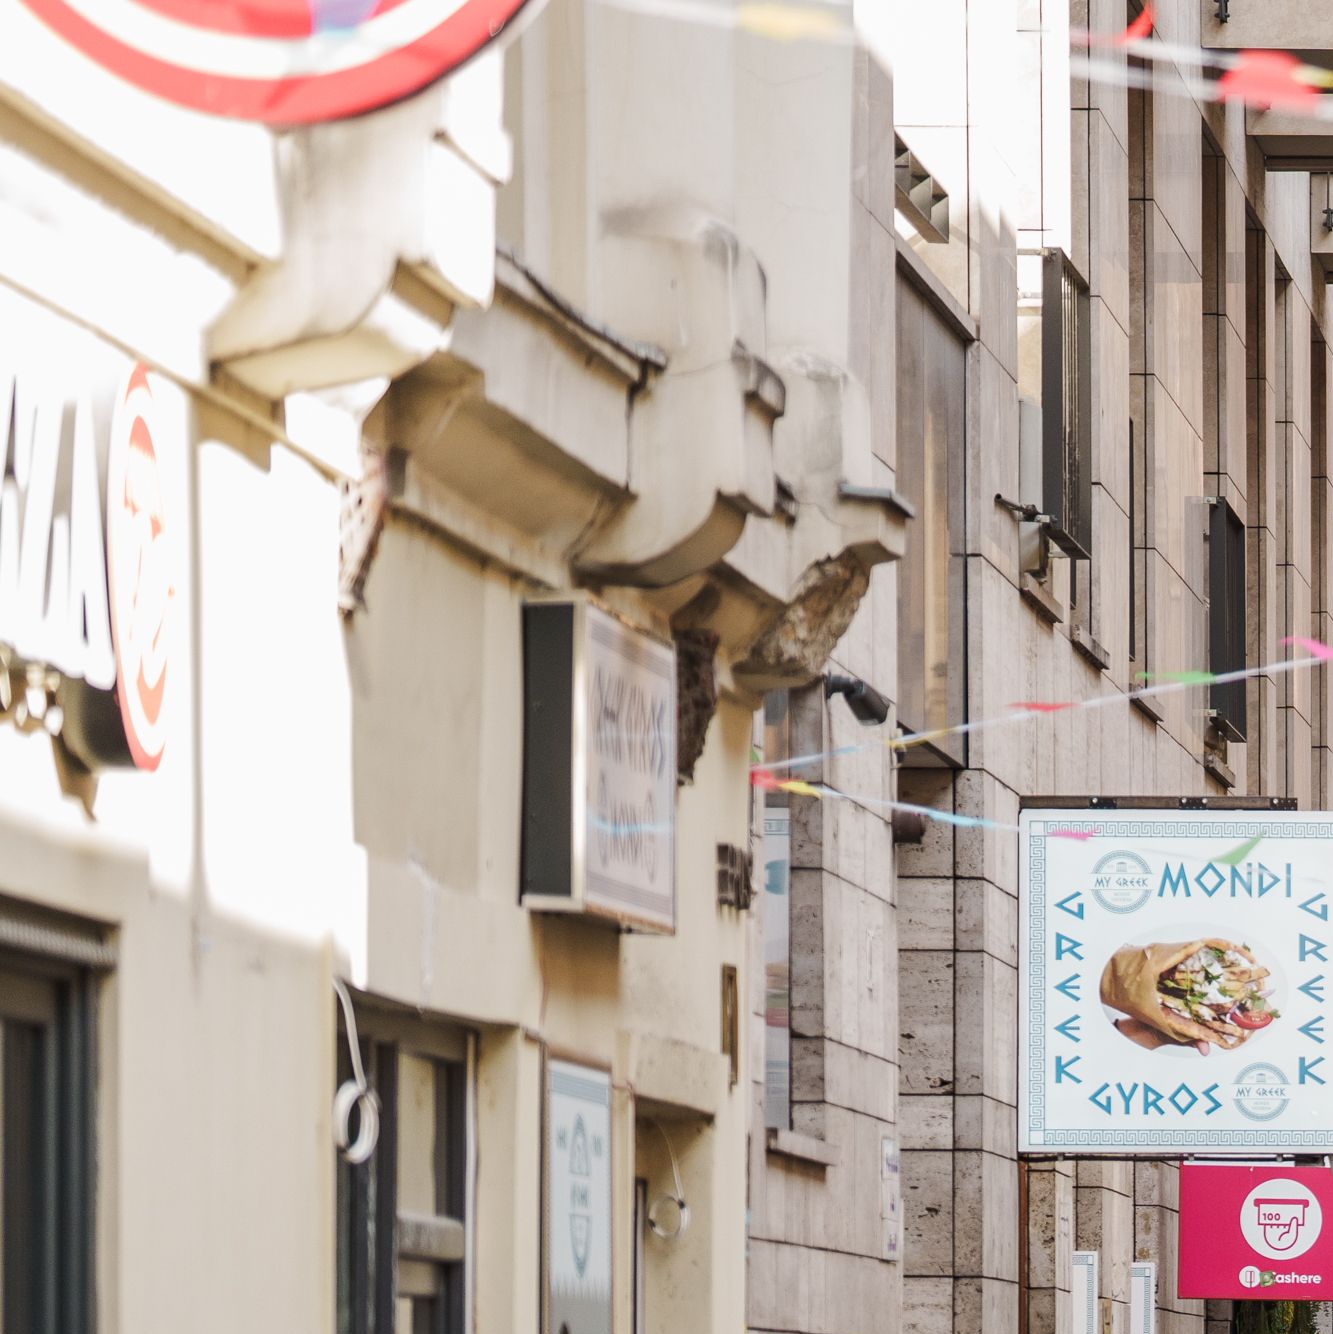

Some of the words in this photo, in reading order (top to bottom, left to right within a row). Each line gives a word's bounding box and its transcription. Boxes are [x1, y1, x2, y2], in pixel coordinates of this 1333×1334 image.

[1095, 877, 1111, 887] MY
[1115, 877, 1149, 887] GREEK
[1157, 862, 1292, 898] MONDI
[1055, 891, 1084, 1084] GREEK
[1297, 892, 1329, 1085] GREEK
[1088, 1082, 1223, 1116] GYROS
[1236, 1087, 1252, 1097] MY
[1256, 1088, 1286, 1096] GREEK
[1262, 1213, 1281, 1221] 100
[1268, 1272, 1322, 1285] ashere
